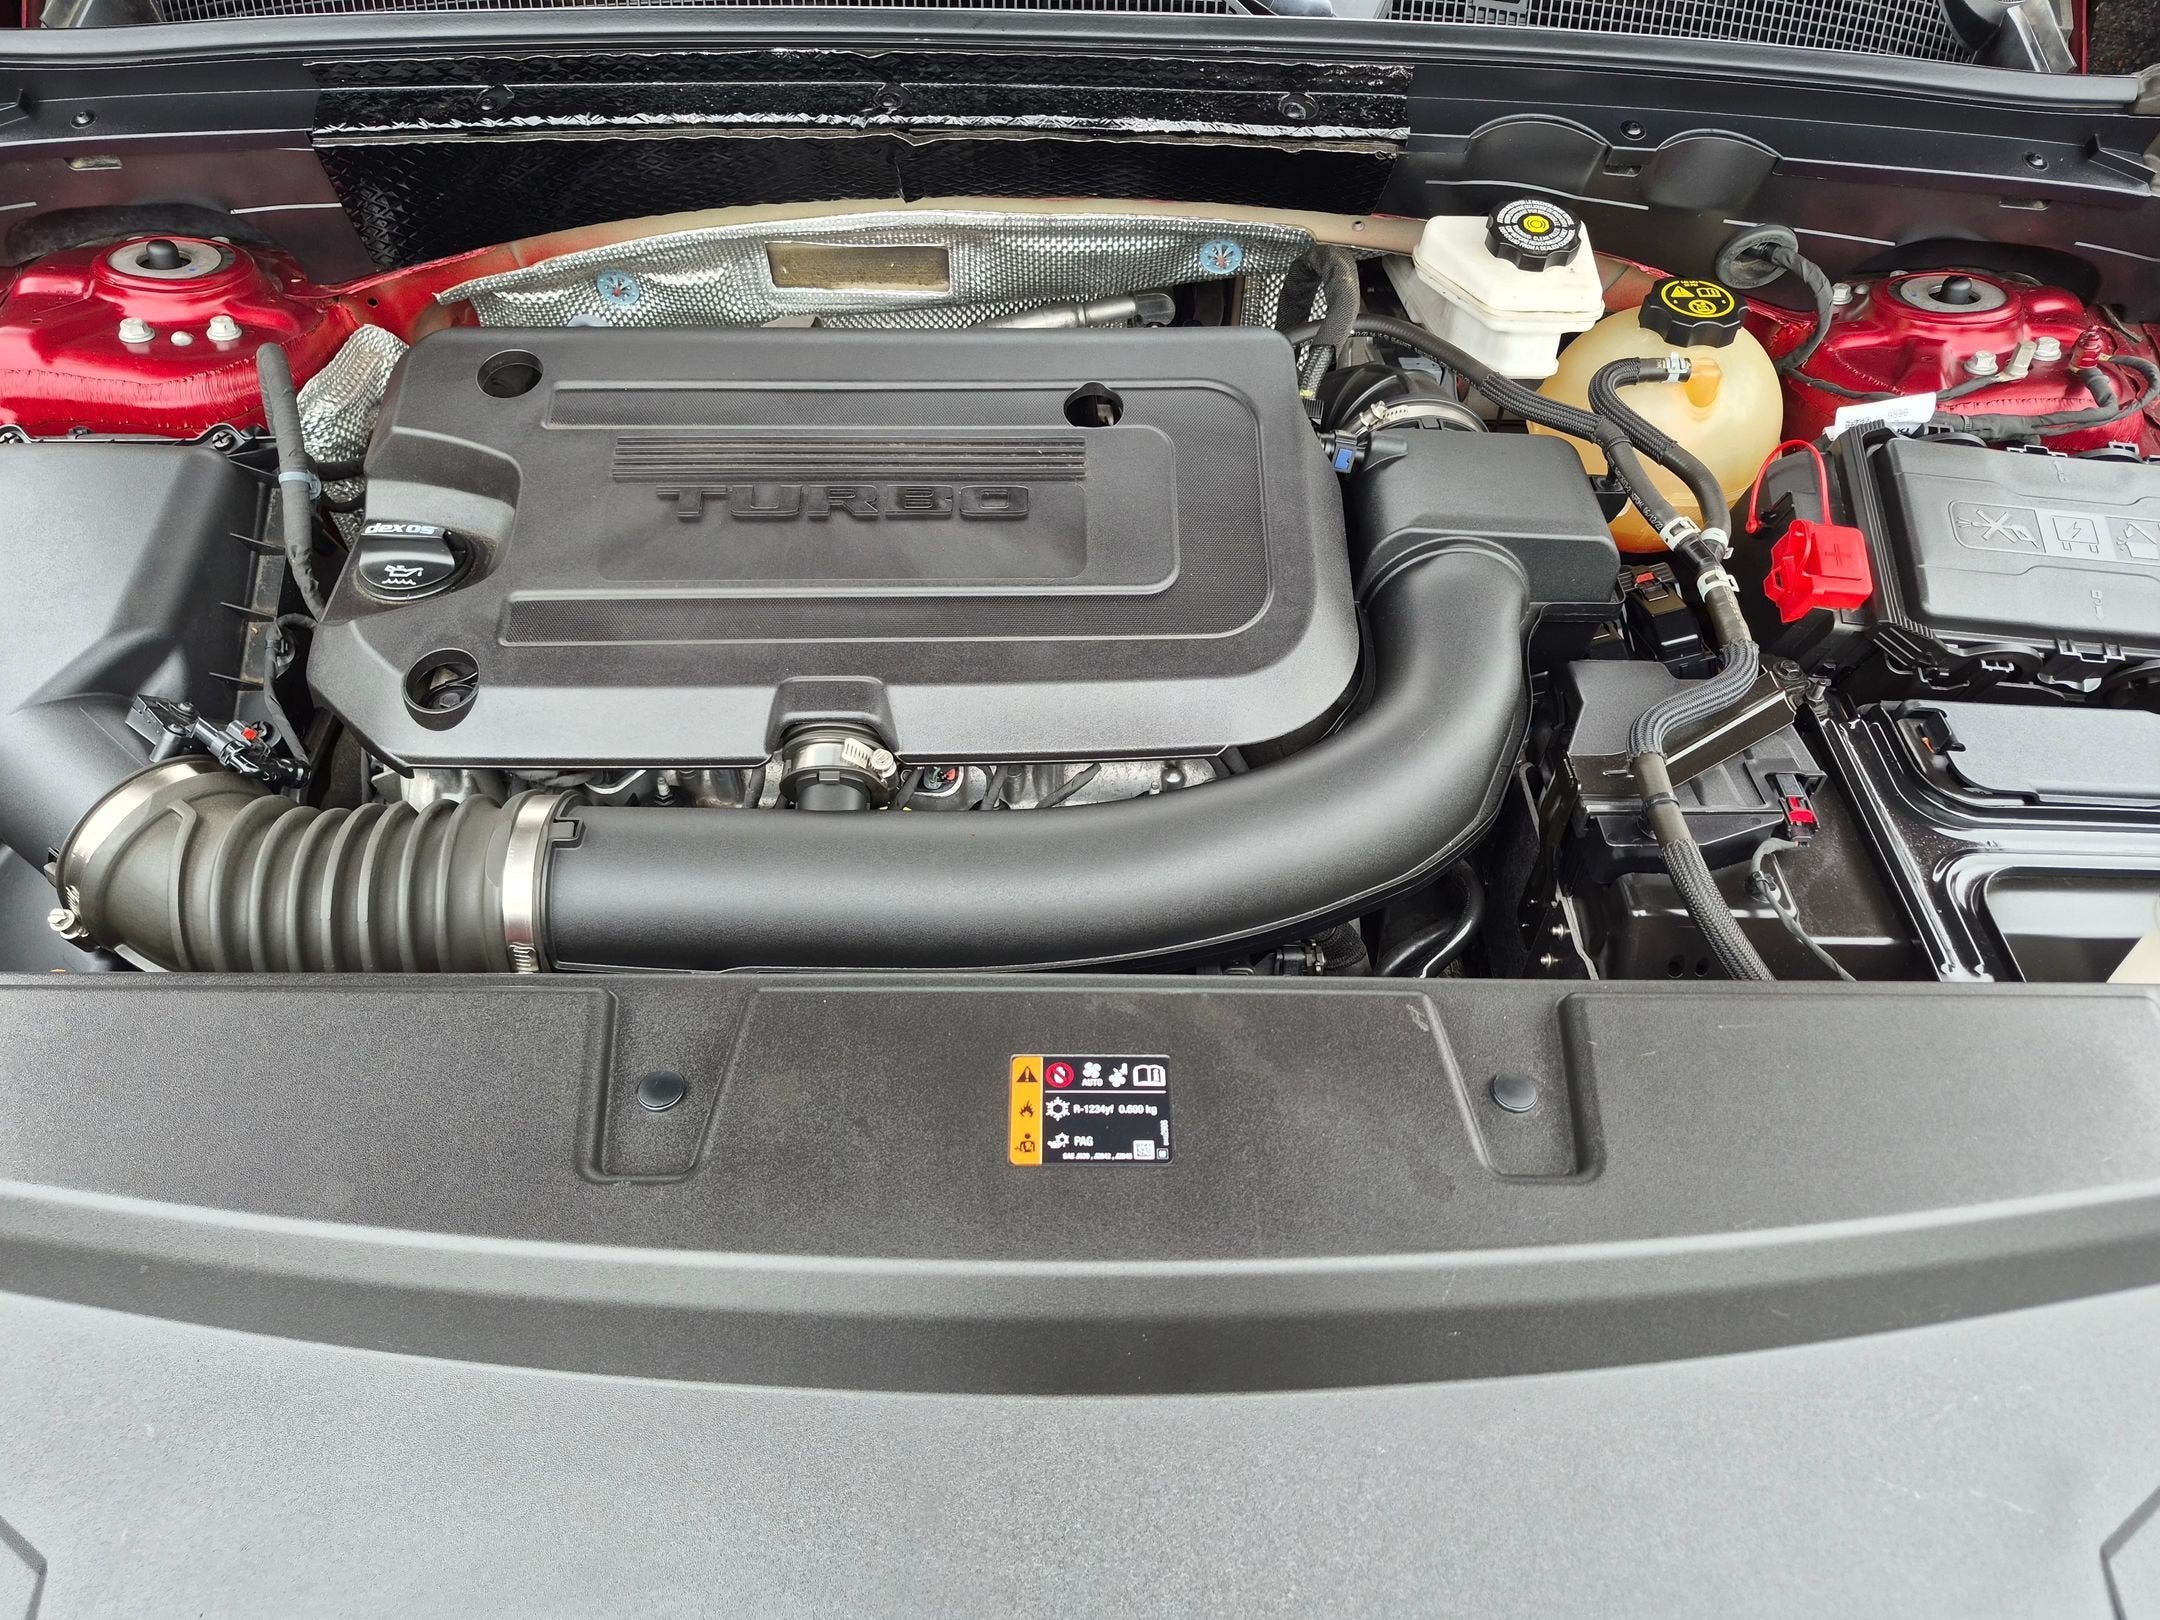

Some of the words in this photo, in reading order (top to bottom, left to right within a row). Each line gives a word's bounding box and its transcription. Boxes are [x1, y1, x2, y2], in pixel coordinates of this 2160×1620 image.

[655, 484, 1030, 520] TURBO
[365, 522, 438, 535] dexos
[1081, 1078, 1104, 1087] AUTO
[1073, 1104, 1114, 1117] R-1234yf
[1145, 1104, 1158, 1116] kg
[1073, 1136, 1094, 1147] PAG
